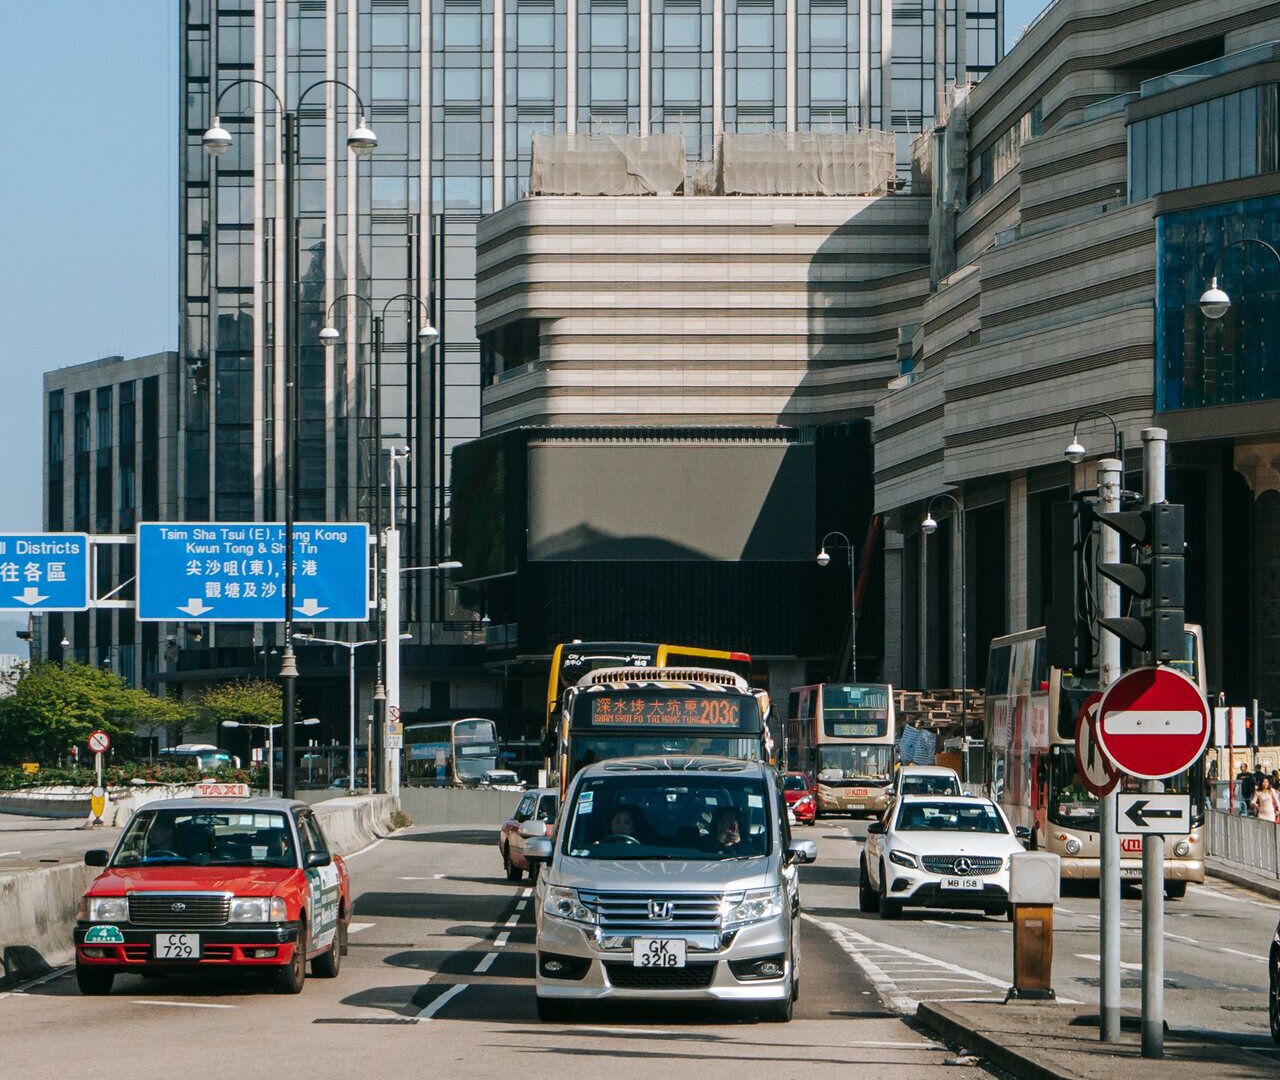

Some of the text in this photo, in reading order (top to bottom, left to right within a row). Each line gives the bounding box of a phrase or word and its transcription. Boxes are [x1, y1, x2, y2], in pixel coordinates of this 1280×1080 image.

[159, 528, 188, 540] Tsim
[193, 528, 216, 540] Sha
[220, 528, 245, 540] Tsui
[314, 529, 348, 543] Kong
[15, 541, 80, 555] Districts
[186, 542, 220, 554] Kwun
[224, 542, 254, 556] Tong
[257, 542, 268, 554] &
[299, 542, 318, 554] Tin
[0, 561, 67, 582] 往各區
[199, 784, 244, 795] TAXI
[947, 879, 977, 888] MB 158
[99, 928, 108, 937] 4
[168, 934, 187, 946] CC
[163, 946, 193, 957] 729
[649, 940, 670, 954] GK
[641, 954, 678, 967] 3218
